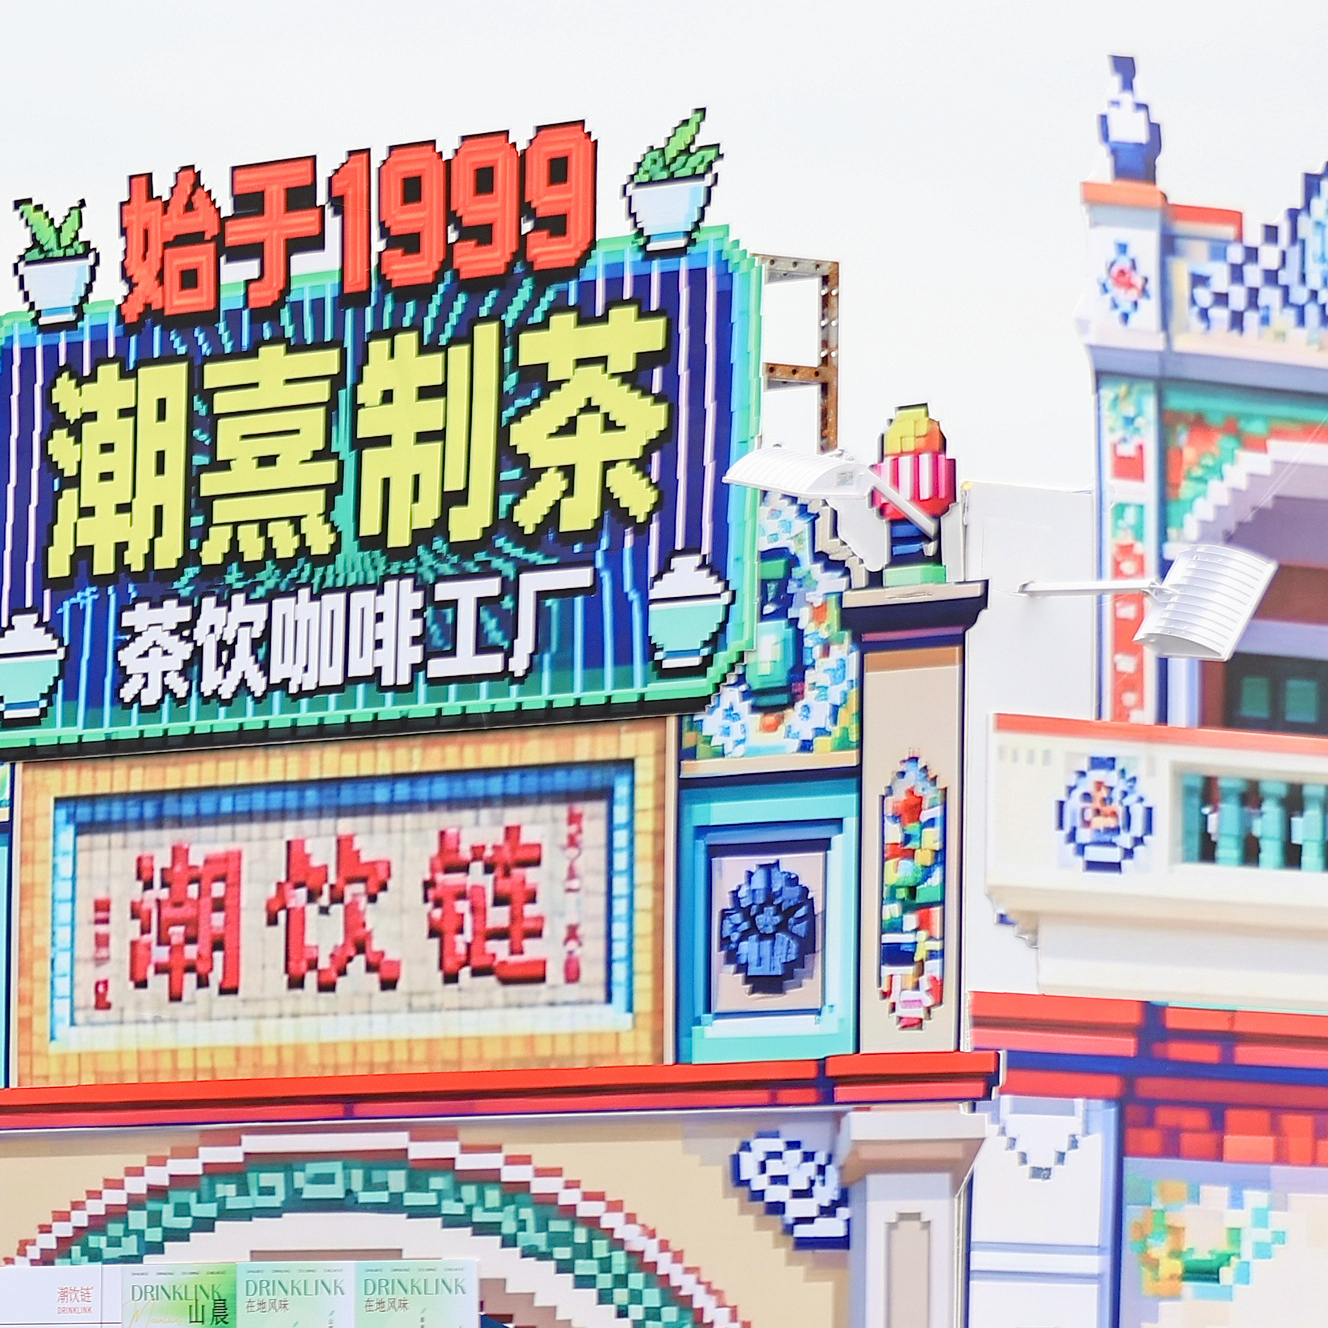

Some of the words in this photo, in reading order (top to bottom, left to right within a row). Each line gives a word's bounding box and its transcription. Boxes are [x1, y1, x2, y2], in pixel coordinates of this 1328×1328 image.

[119, 119, 598, 324] 始于1999
[47, 304, 671, 580] 潮熹制茶
[117, 568, 594, 705] 茶饮咖啡工厂
[129, 824, 547, 1001] 潮饮链
[57, 1306, 93, 1315] DRINKLINK
[245, 1279, 345, 1297] DRINKLINK
[364, 1278, 466, 1296] DRINKLINK
